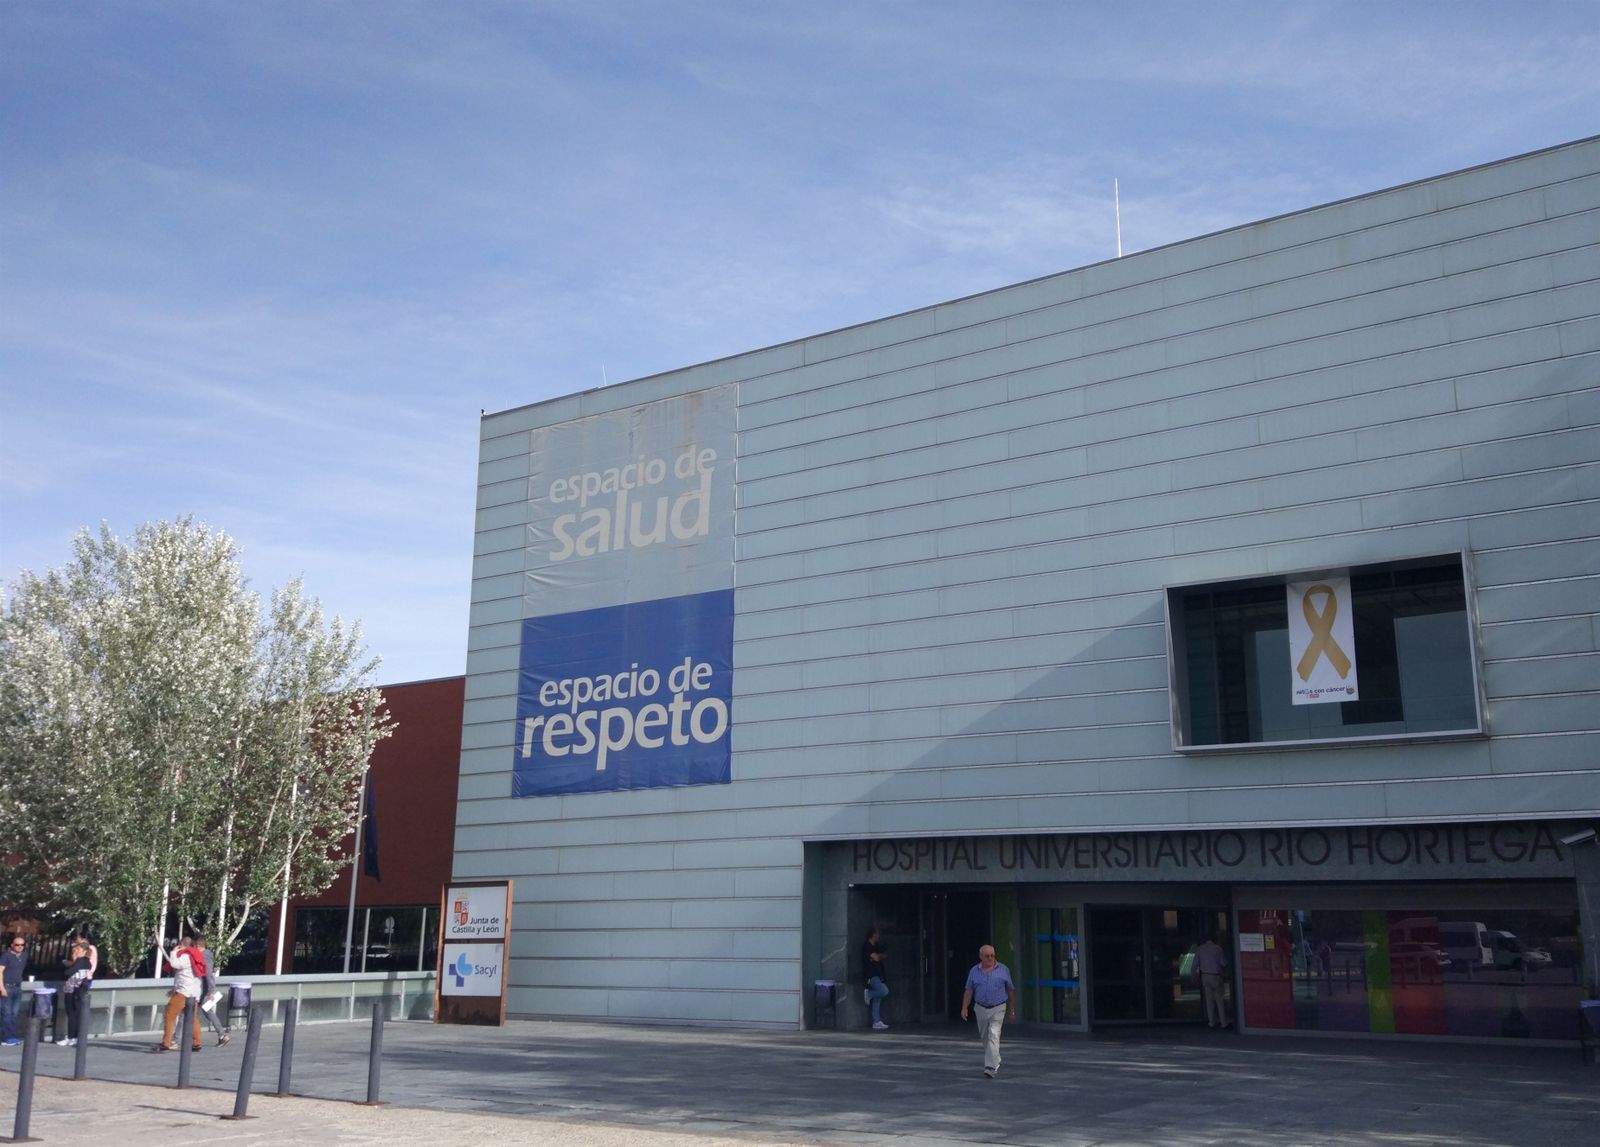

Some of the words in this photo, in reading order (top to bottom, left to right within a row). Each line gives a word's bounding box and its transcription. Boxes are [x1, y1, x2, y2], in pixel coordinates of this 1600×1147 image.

[549, 454, 666, 506] espacio
[674, 444, 717, 474] de
[549, 471, 713, 561] salud
[539, 662, 659, 713] espacio
[668, 656, 712, 692] de
[521, 692, 728, 770] respeto
[852, 837, 987, 872] HOSPITAL
[999, 830, 1246, 871] UNIVERSITARIO
[1347, 824, 1564, 866] HORTEGA
[452, 926, 475, 934] Castilla
[476, 927, 481, 935] y
[483, 925, 499, 933] León
[470, 917, 488, 925] Junta
[474, 964, 497, 978] Sacyl
